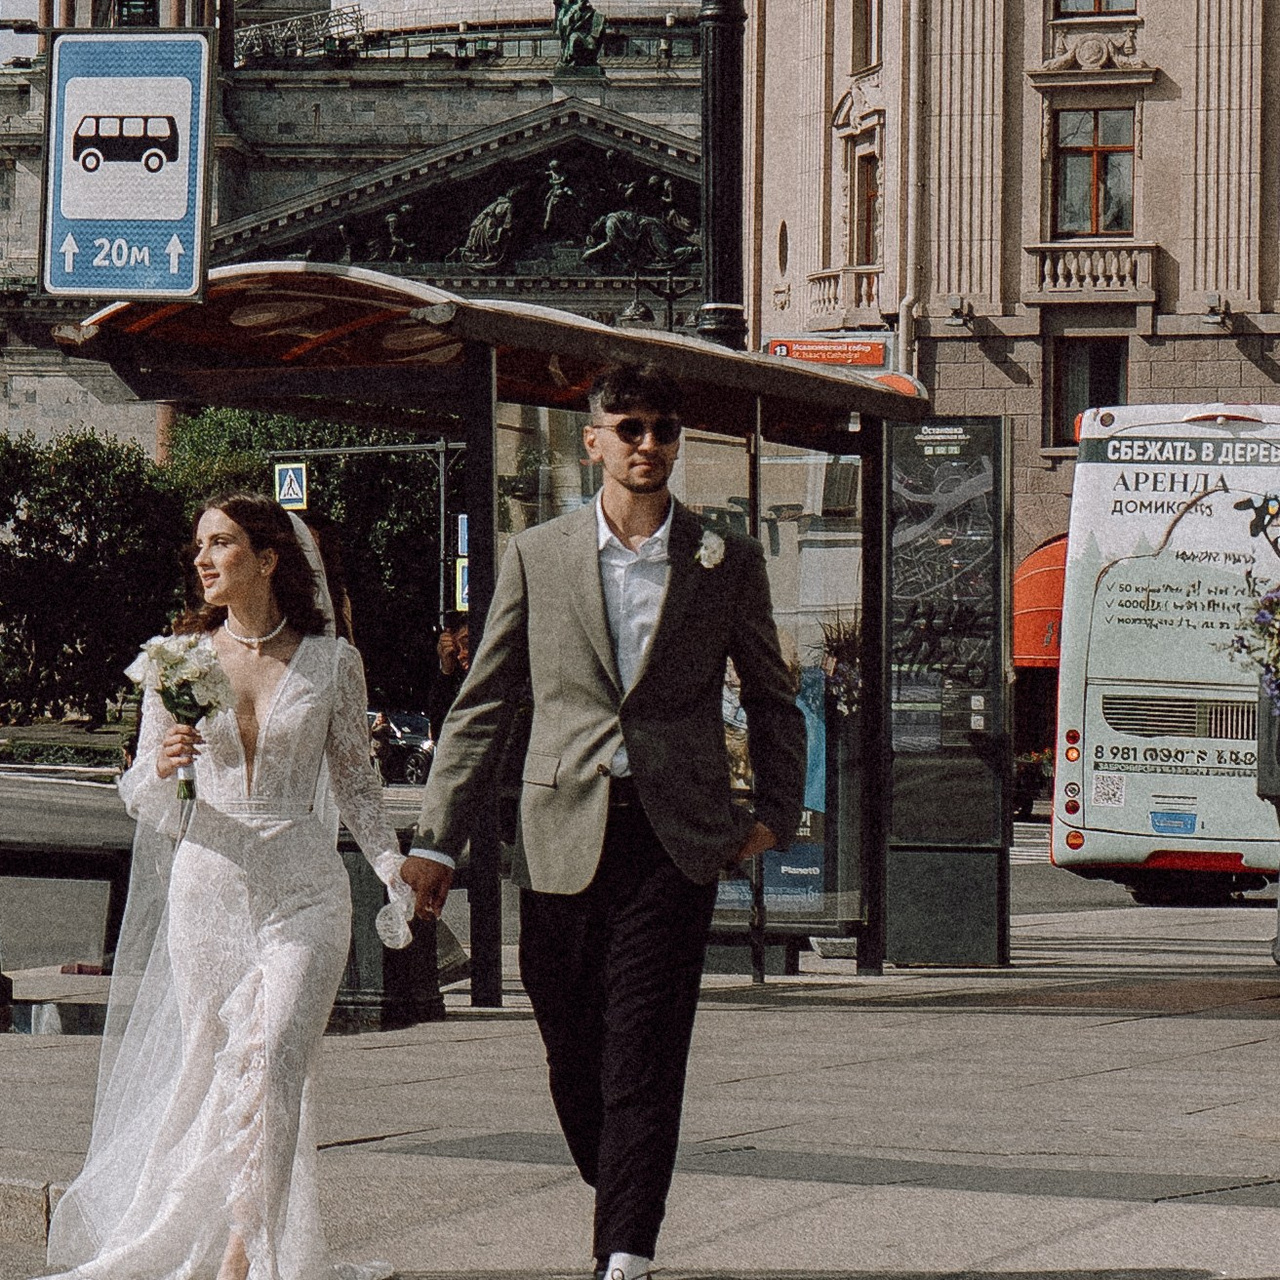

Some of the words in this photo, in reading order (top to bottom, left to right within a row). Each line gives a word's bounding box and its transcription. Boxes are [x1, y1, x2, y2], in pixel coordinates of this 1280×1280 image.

[91, 237, 151, 268] 20м
[1106, 440, 1197, 462] СБЕЖАТЬ
[1201, 442, 1215, 462] В
[1112, 470, 1231, 496] АРЕНДА
[1094, 745, 1104, 759] 8
[1109, 746, 1138, 762] 981
